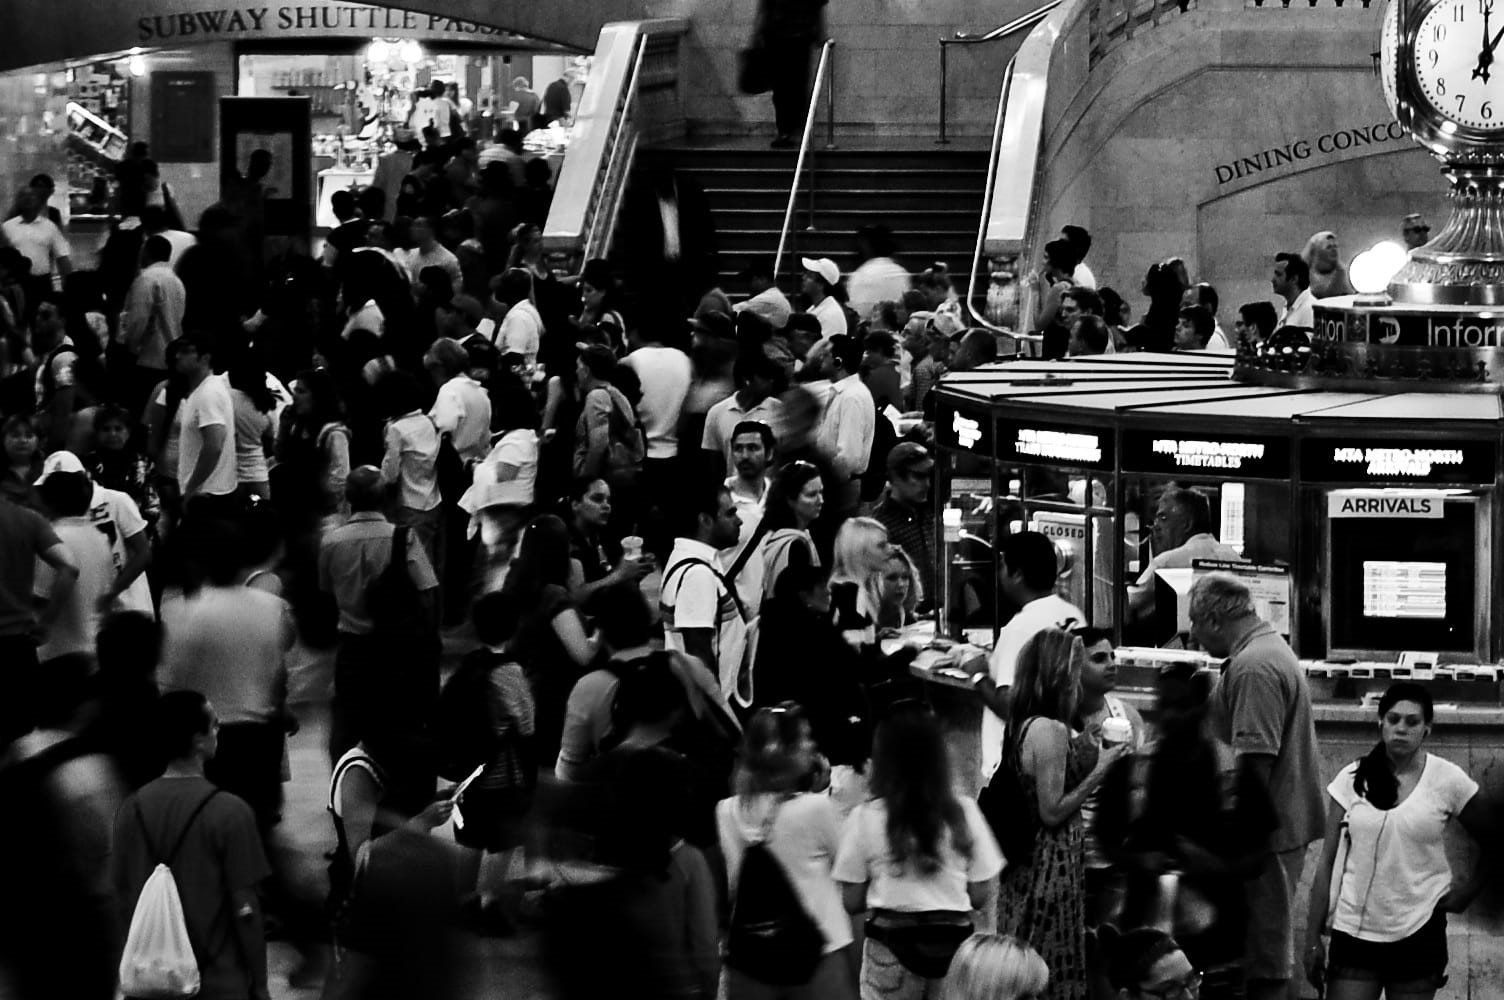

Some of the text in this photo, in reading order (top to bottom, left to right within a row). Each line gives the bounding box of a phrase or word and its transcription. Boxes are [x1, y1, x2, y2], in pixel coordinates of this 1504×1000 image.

[1454, 5, 1464, 22] 11
[137, 7, 268, 41] SUBWAY
[278, 6, 417, 30] SHUTTLE
[1433, 24, 1447, 42] 10
[1428, 49, 1439, 69] 9
[1436, 77, 1446, 96] 8
[1455, 94, 1466, 113] 7
[1480, 100, 1493, 119] 6
[1215, 121, 1406, 185] DINING CONCO
[1174, 454, 1241, 468] TIMETABLES
[1341, 498, 1432, 513] ARRIVALS
[1043, 525, 1084, 539] CLOSED
